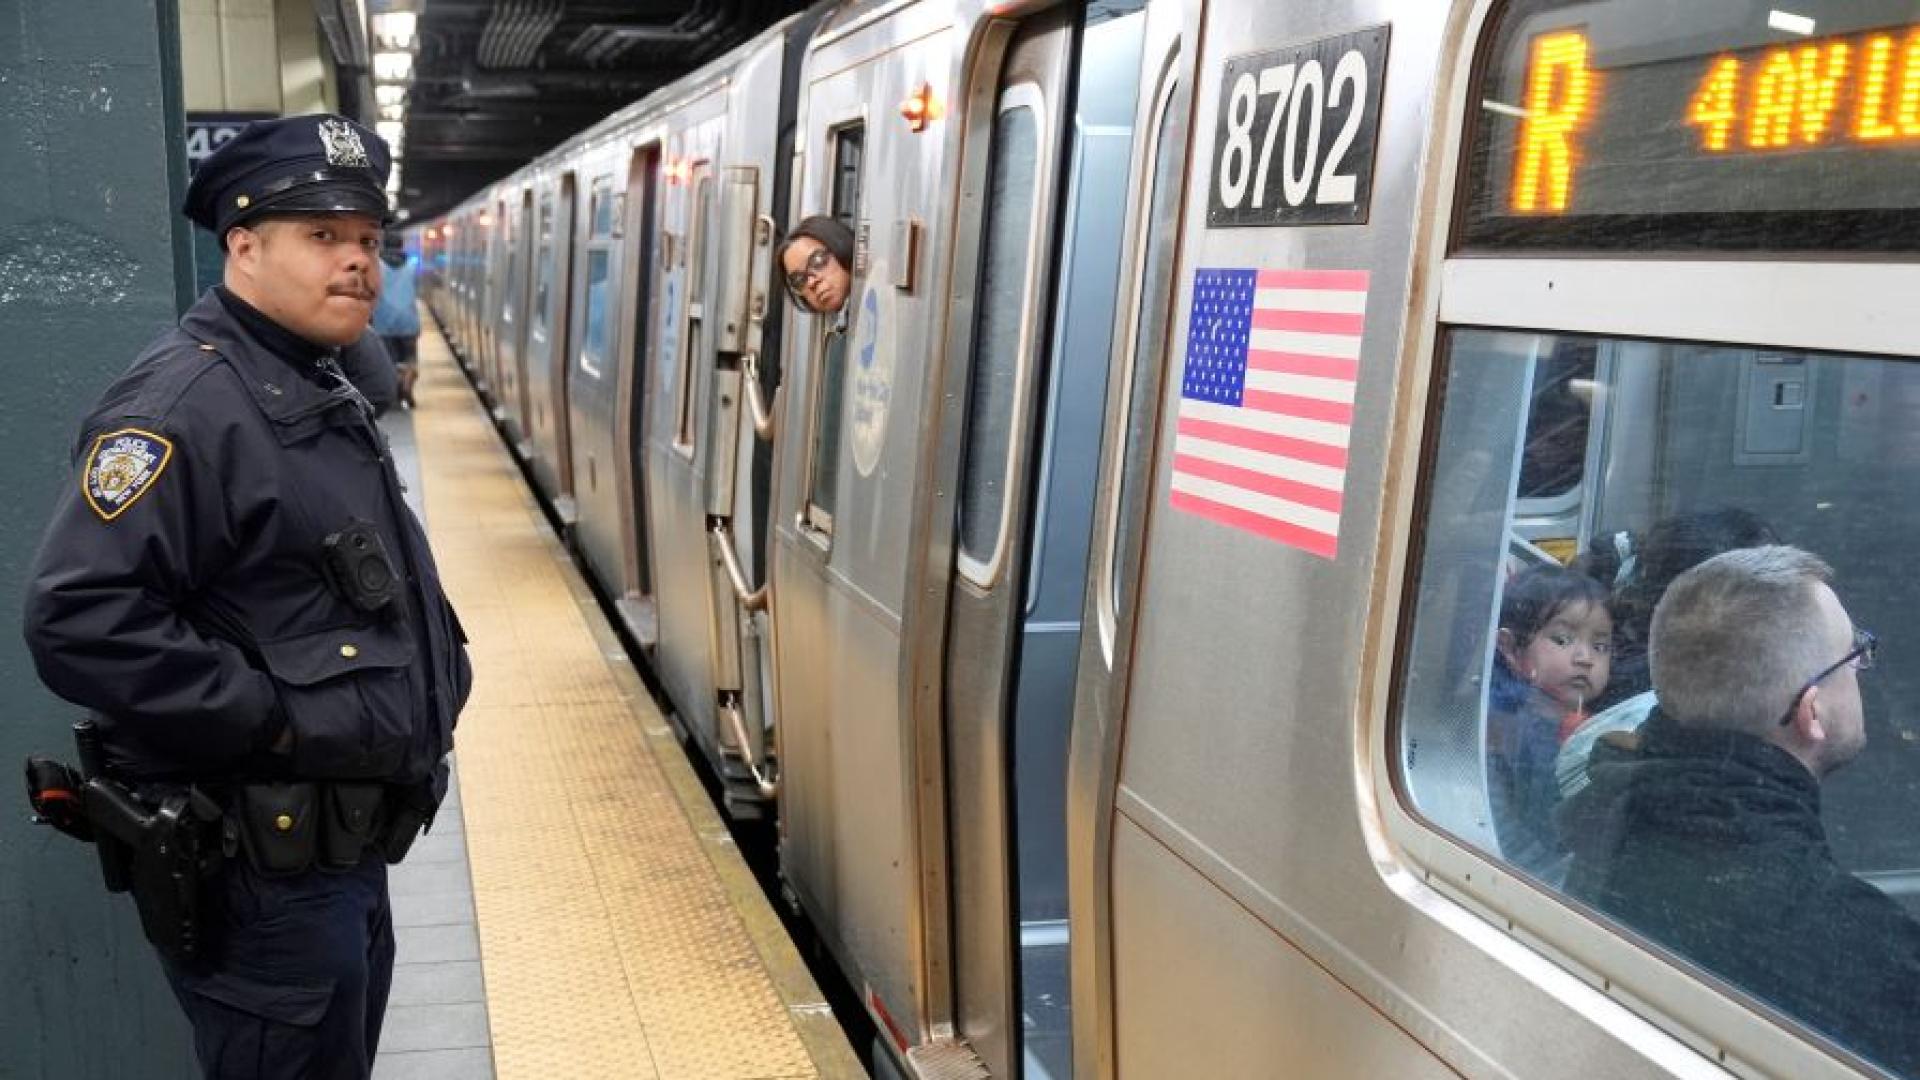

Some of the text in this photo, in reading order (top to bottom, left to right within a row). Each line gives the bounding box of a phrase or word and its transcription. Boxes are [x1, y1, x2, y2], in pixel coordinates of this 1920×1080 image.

[1220, 50, 1368, 209] 8702
[1511, 30, 1589, 212] R
[1694, 57, 1739, 151] 4
[1750, 43, 1849, 147] AV
